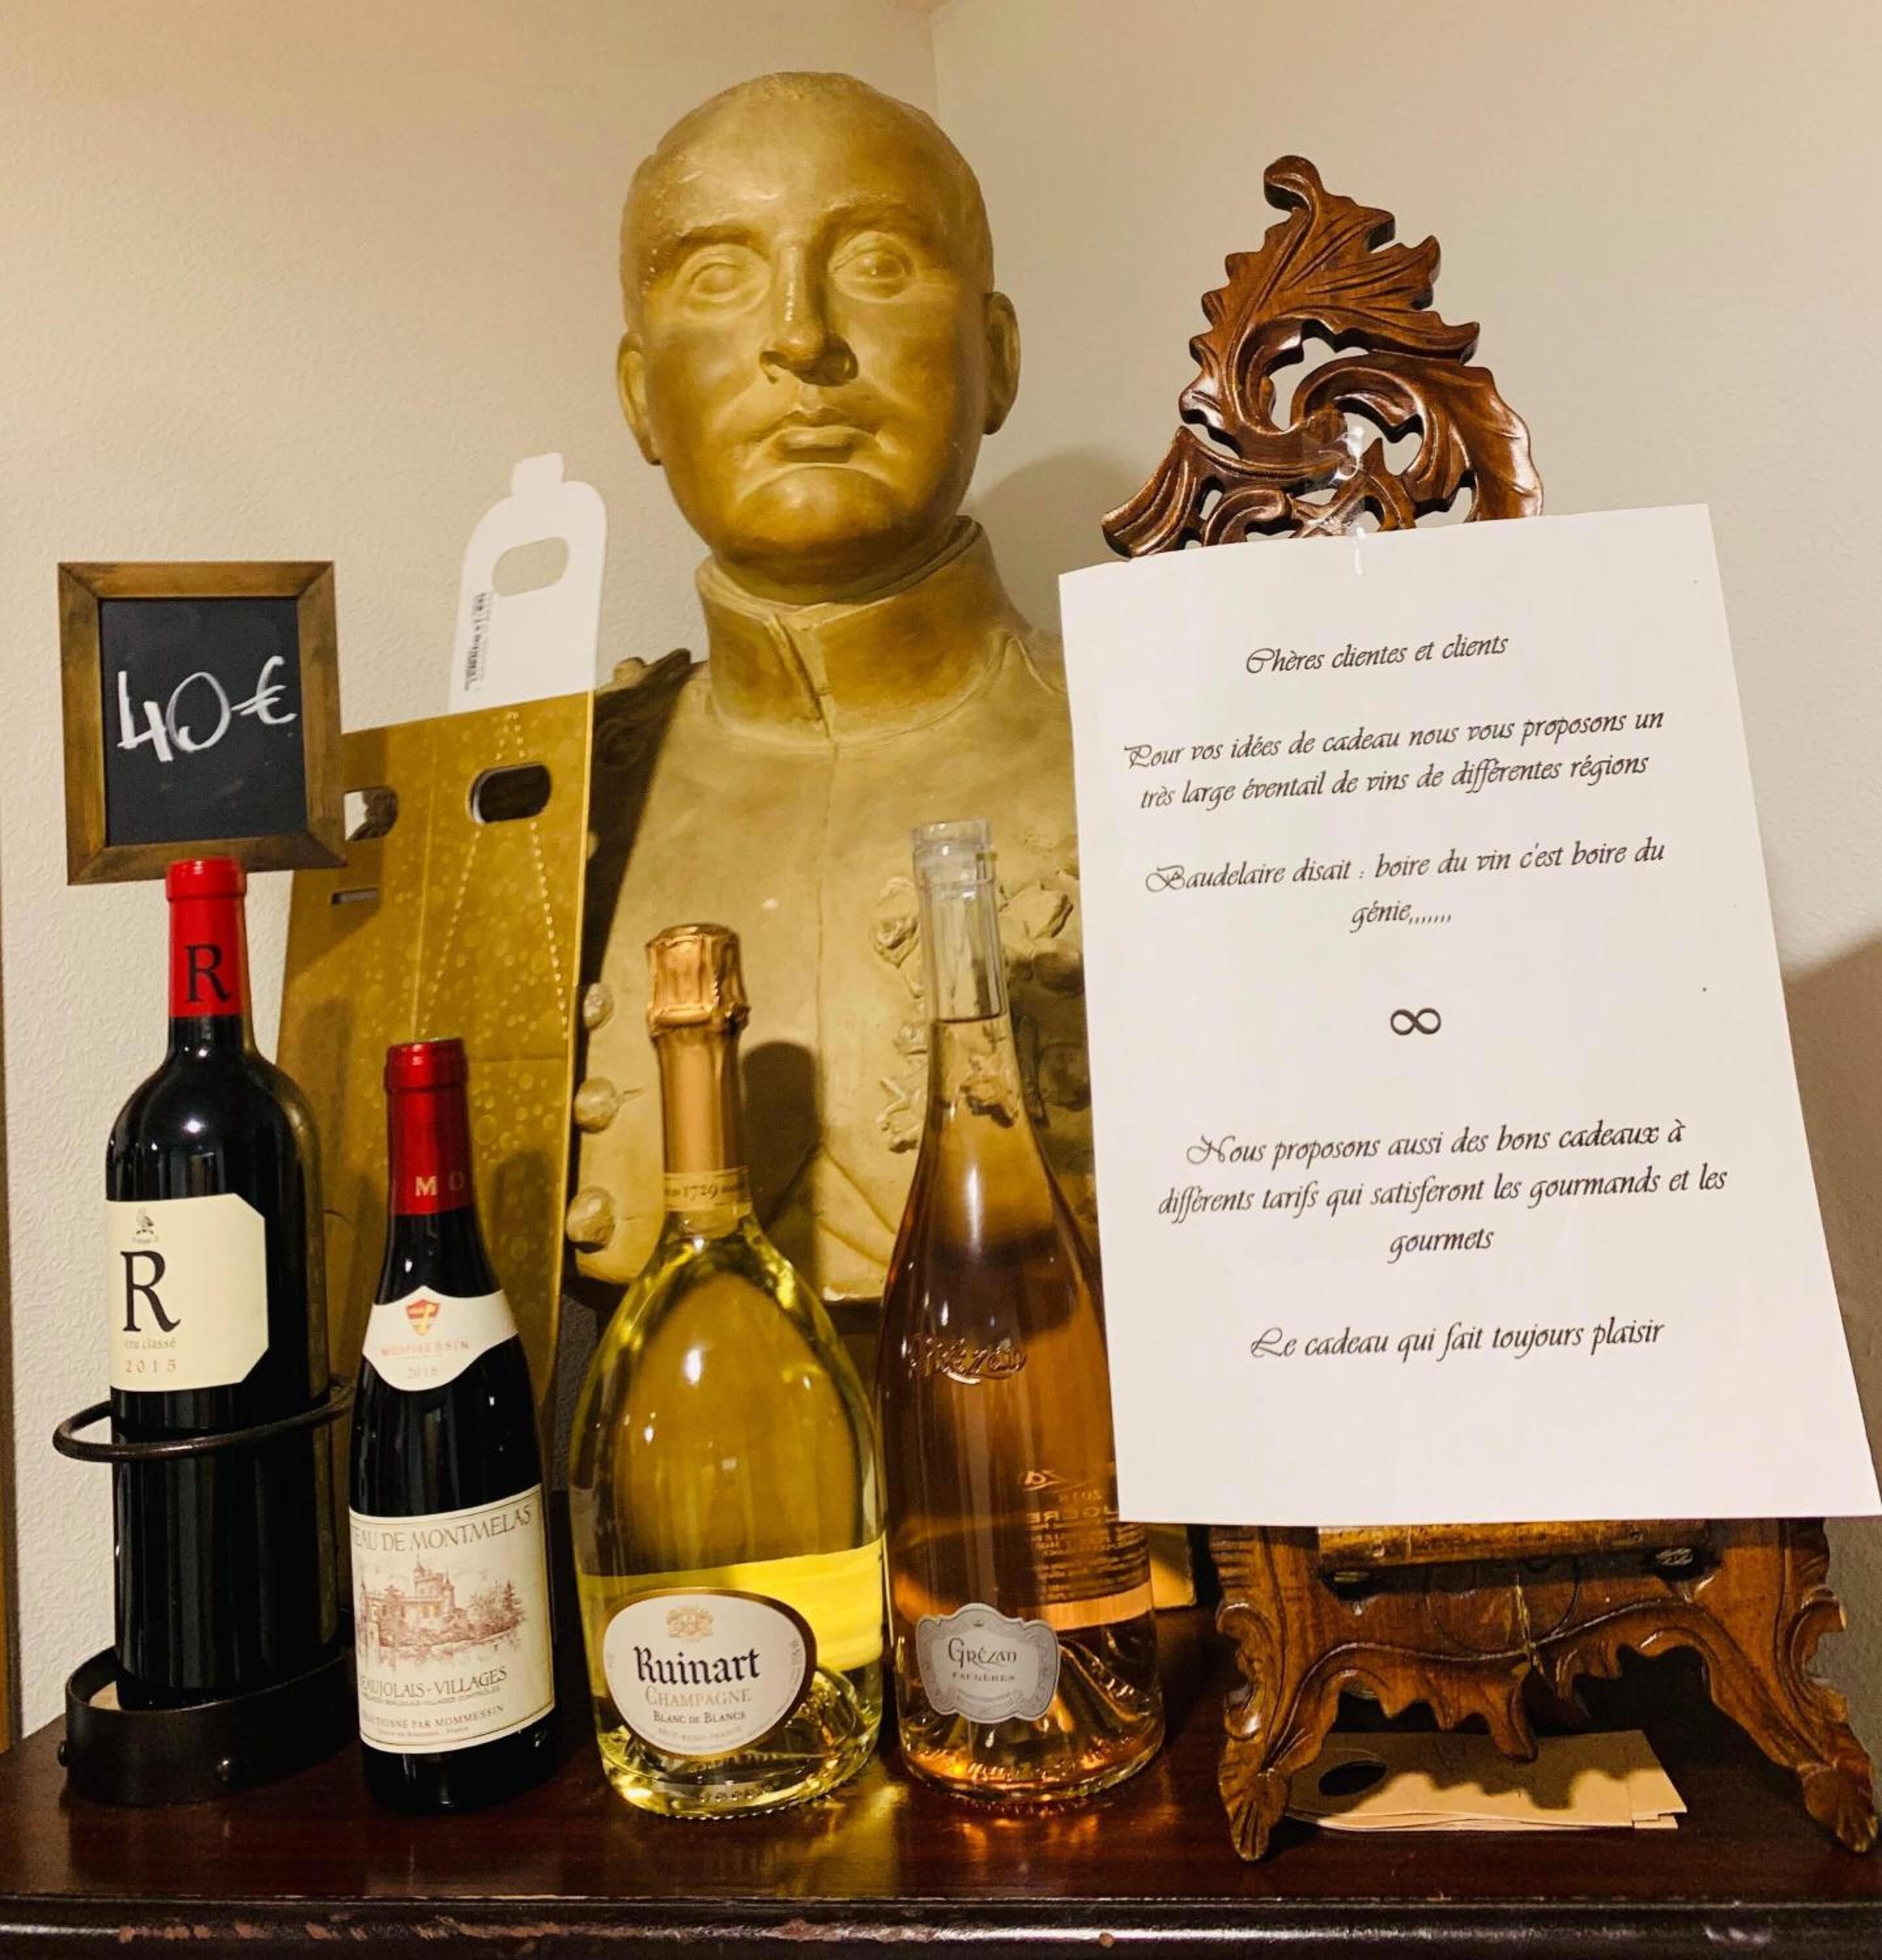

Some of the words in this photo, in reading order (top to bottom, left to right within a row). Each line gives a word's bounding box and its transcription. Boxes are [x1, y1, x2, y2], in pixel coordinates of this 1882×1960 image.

[1246, 648, 1325, 674] Chères
[1332, 644, 1408, 668] clientes
[1415, 642, 1434, 661] et
[1442, 634, 1509, 659] clients
[117, 655, 297, 762] 40€
[1124, 745, 1184, 768] Pour
[1192, 744, 1223, 760] vos
[1231, 734, 1281, 758] idées
[1289, 730, 1315, 754] de
[1323, 727, 1400, 752] cadeau
[1409, 727, 1459, 746] nous
[1468, 723, 1515, 741] vous
[1521, 715, 1627, 746] proposons
[1635, 712, 1664, 729] un
[1141, 786, 1174, 808] très
[1182, 780, 1236, 811] large
[1243, 771, 1326, 799] éventail
[1332, 770, 1359, 794] de
[1367, 771, 1410, 791] vins
[1417, 763, 1444, 788] de
[1451, 758, 1562, 794] différentes
[1570, 755, 1649, 786] régions
[1146, 861, 1285, 891] Baudelaire
[1293, 857, 1351, 881] disait
[1375, 853, 1430, 877] boire
[1438, 848, 1467, 874] du
[1477, 850, 1511, 871] vin
[1520, 843, 1564, 868] c'est
[1571, 840, 1627, 865] boire
[1634, 836, 1664, 862] du
[185, 942, 231, 1003] R
[1187, 1135, 1266, 1164] Nous
[1272, 1140, 1380, 1171] proposons
[1388, 1132, 1443, 1155] aussi
[1451, 1126, 1489, 1153] des
[1496, 1124, 1551, 1151] bons
[1559, 1119, 1659, 1148] cadeaux
[1668, 1119, 1686, 1143] à
[1159, 1186, 1255, 1223] différents
[1263, 1181, 1319, 1218] tarifs
[1327, 1184, 1363, 1217] qui
[1370, 1175, 1484, 1213] satisferont
[1494, 1173, 1522, 1199] les
[1528, 1166, 1660, 1209] gourmands
[1669, 1170, 1689, 1191] et
[1699, 1162, 1727, 1190] les
[1388, 1228, 1494, 1264] gourmets
[120, 1250, 181, 1332] R
[1251, 1328, 1296, 1357] Le
[1305, 1327, 1389, 1355] cadeau
[1398, 1328, 1436, 1363] qui
[1436, 1322, 1483, 1362] fait
[1493, 1324, 1584, 1359] toujours
[1591, 1316, 1664, 1356] plaisir
[125, 1359, 177, 1373] 2015
[381, 1531, 405, 1552] DE
[409, 1504, 532, 1550] MONTMELAS
[633, 1645, 761, 1685] Ruinart
[646, 1686, 752, 1707] CHAMPAGNE
[653, 1710, 686, 1723] BLANC
